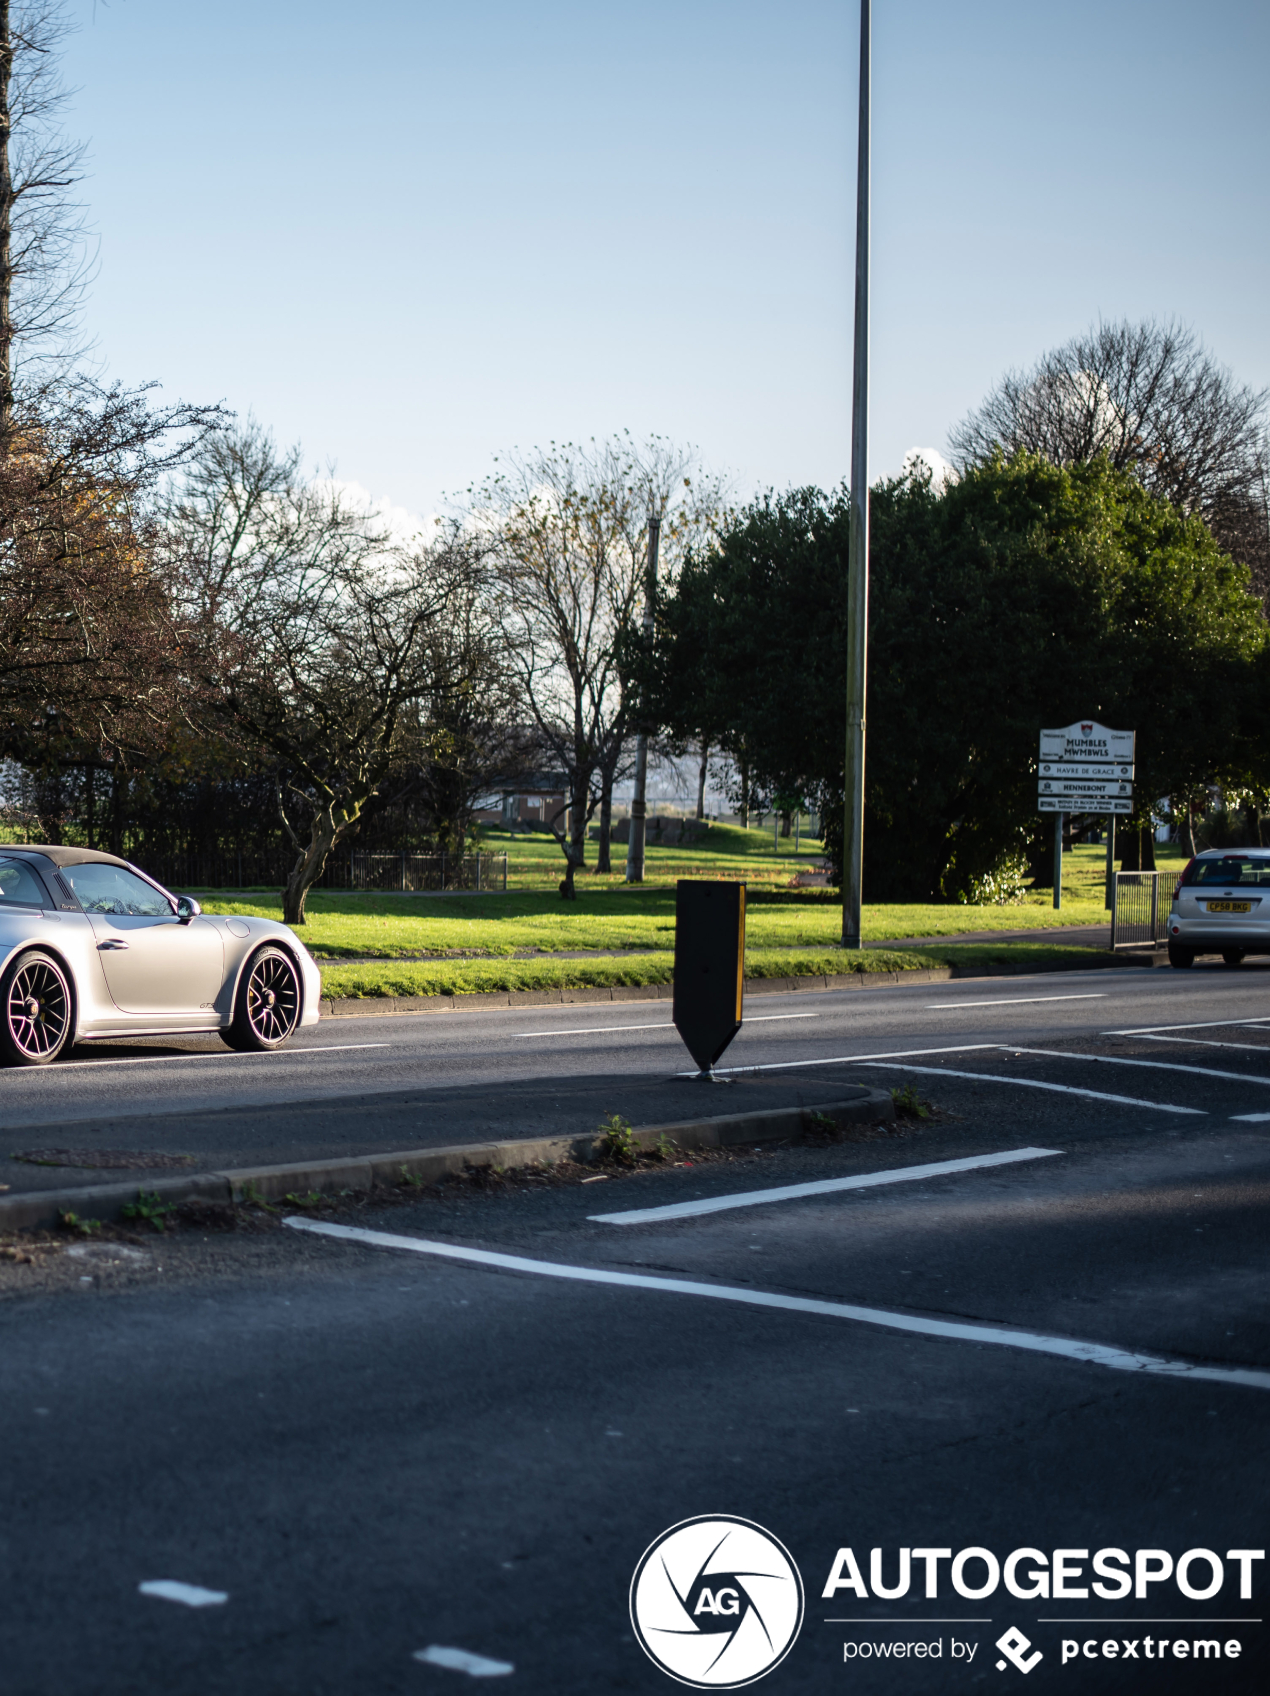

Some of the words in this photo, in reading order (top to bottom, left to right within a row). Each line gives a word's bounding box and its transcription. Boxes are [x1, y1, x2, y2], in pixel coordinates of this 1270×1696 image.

[1066, 739, 1107, 747] MUMBLES
[1064, 748, 1109, 757] MWMBWLS
[1063, 784, 1106, 792] HENNEBONT
[1209, 902, 1230, 911] CP58
[1232, 903, 1248, 911] BKG
